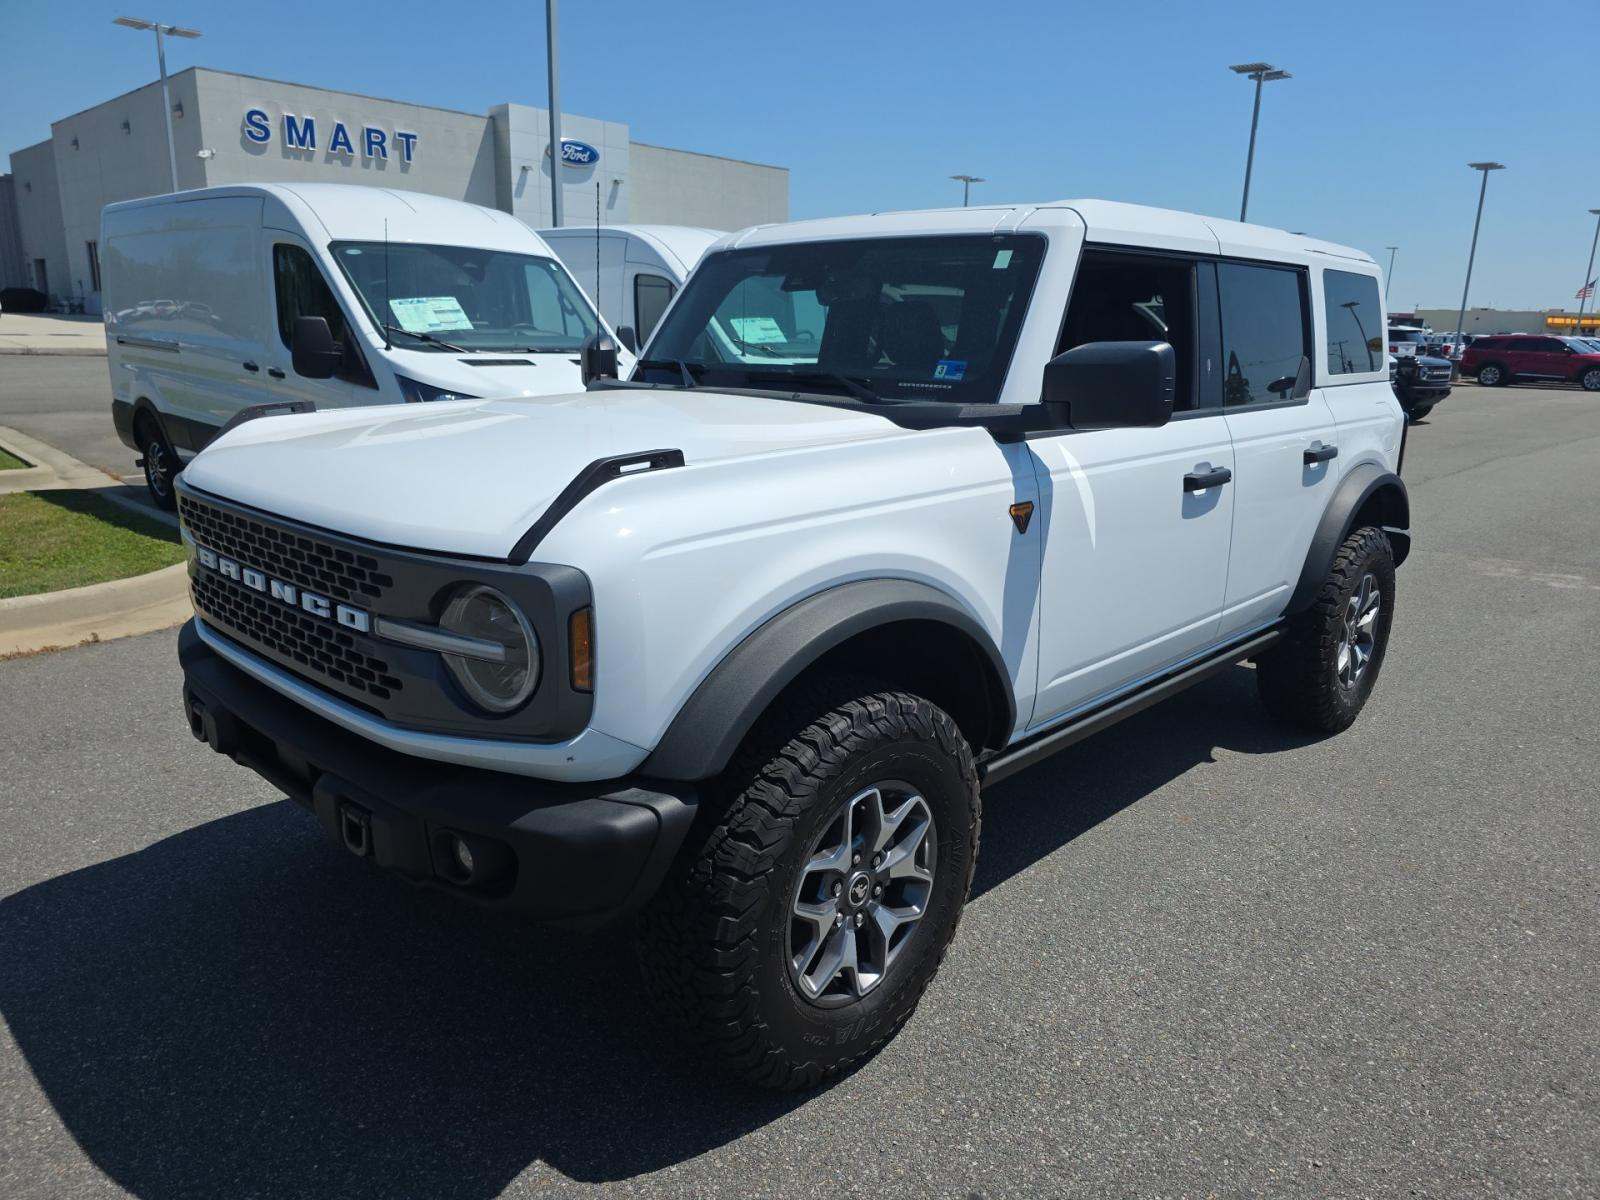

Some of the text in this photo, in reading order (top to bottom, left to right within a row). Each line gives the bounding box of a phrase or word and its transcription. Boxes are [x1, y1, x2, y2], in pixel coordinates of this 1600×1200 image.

[245, 108, 418, 163] SMART
[562, 144, 589, 162] Ford
[199, 547, 370, 633] BRONCO
